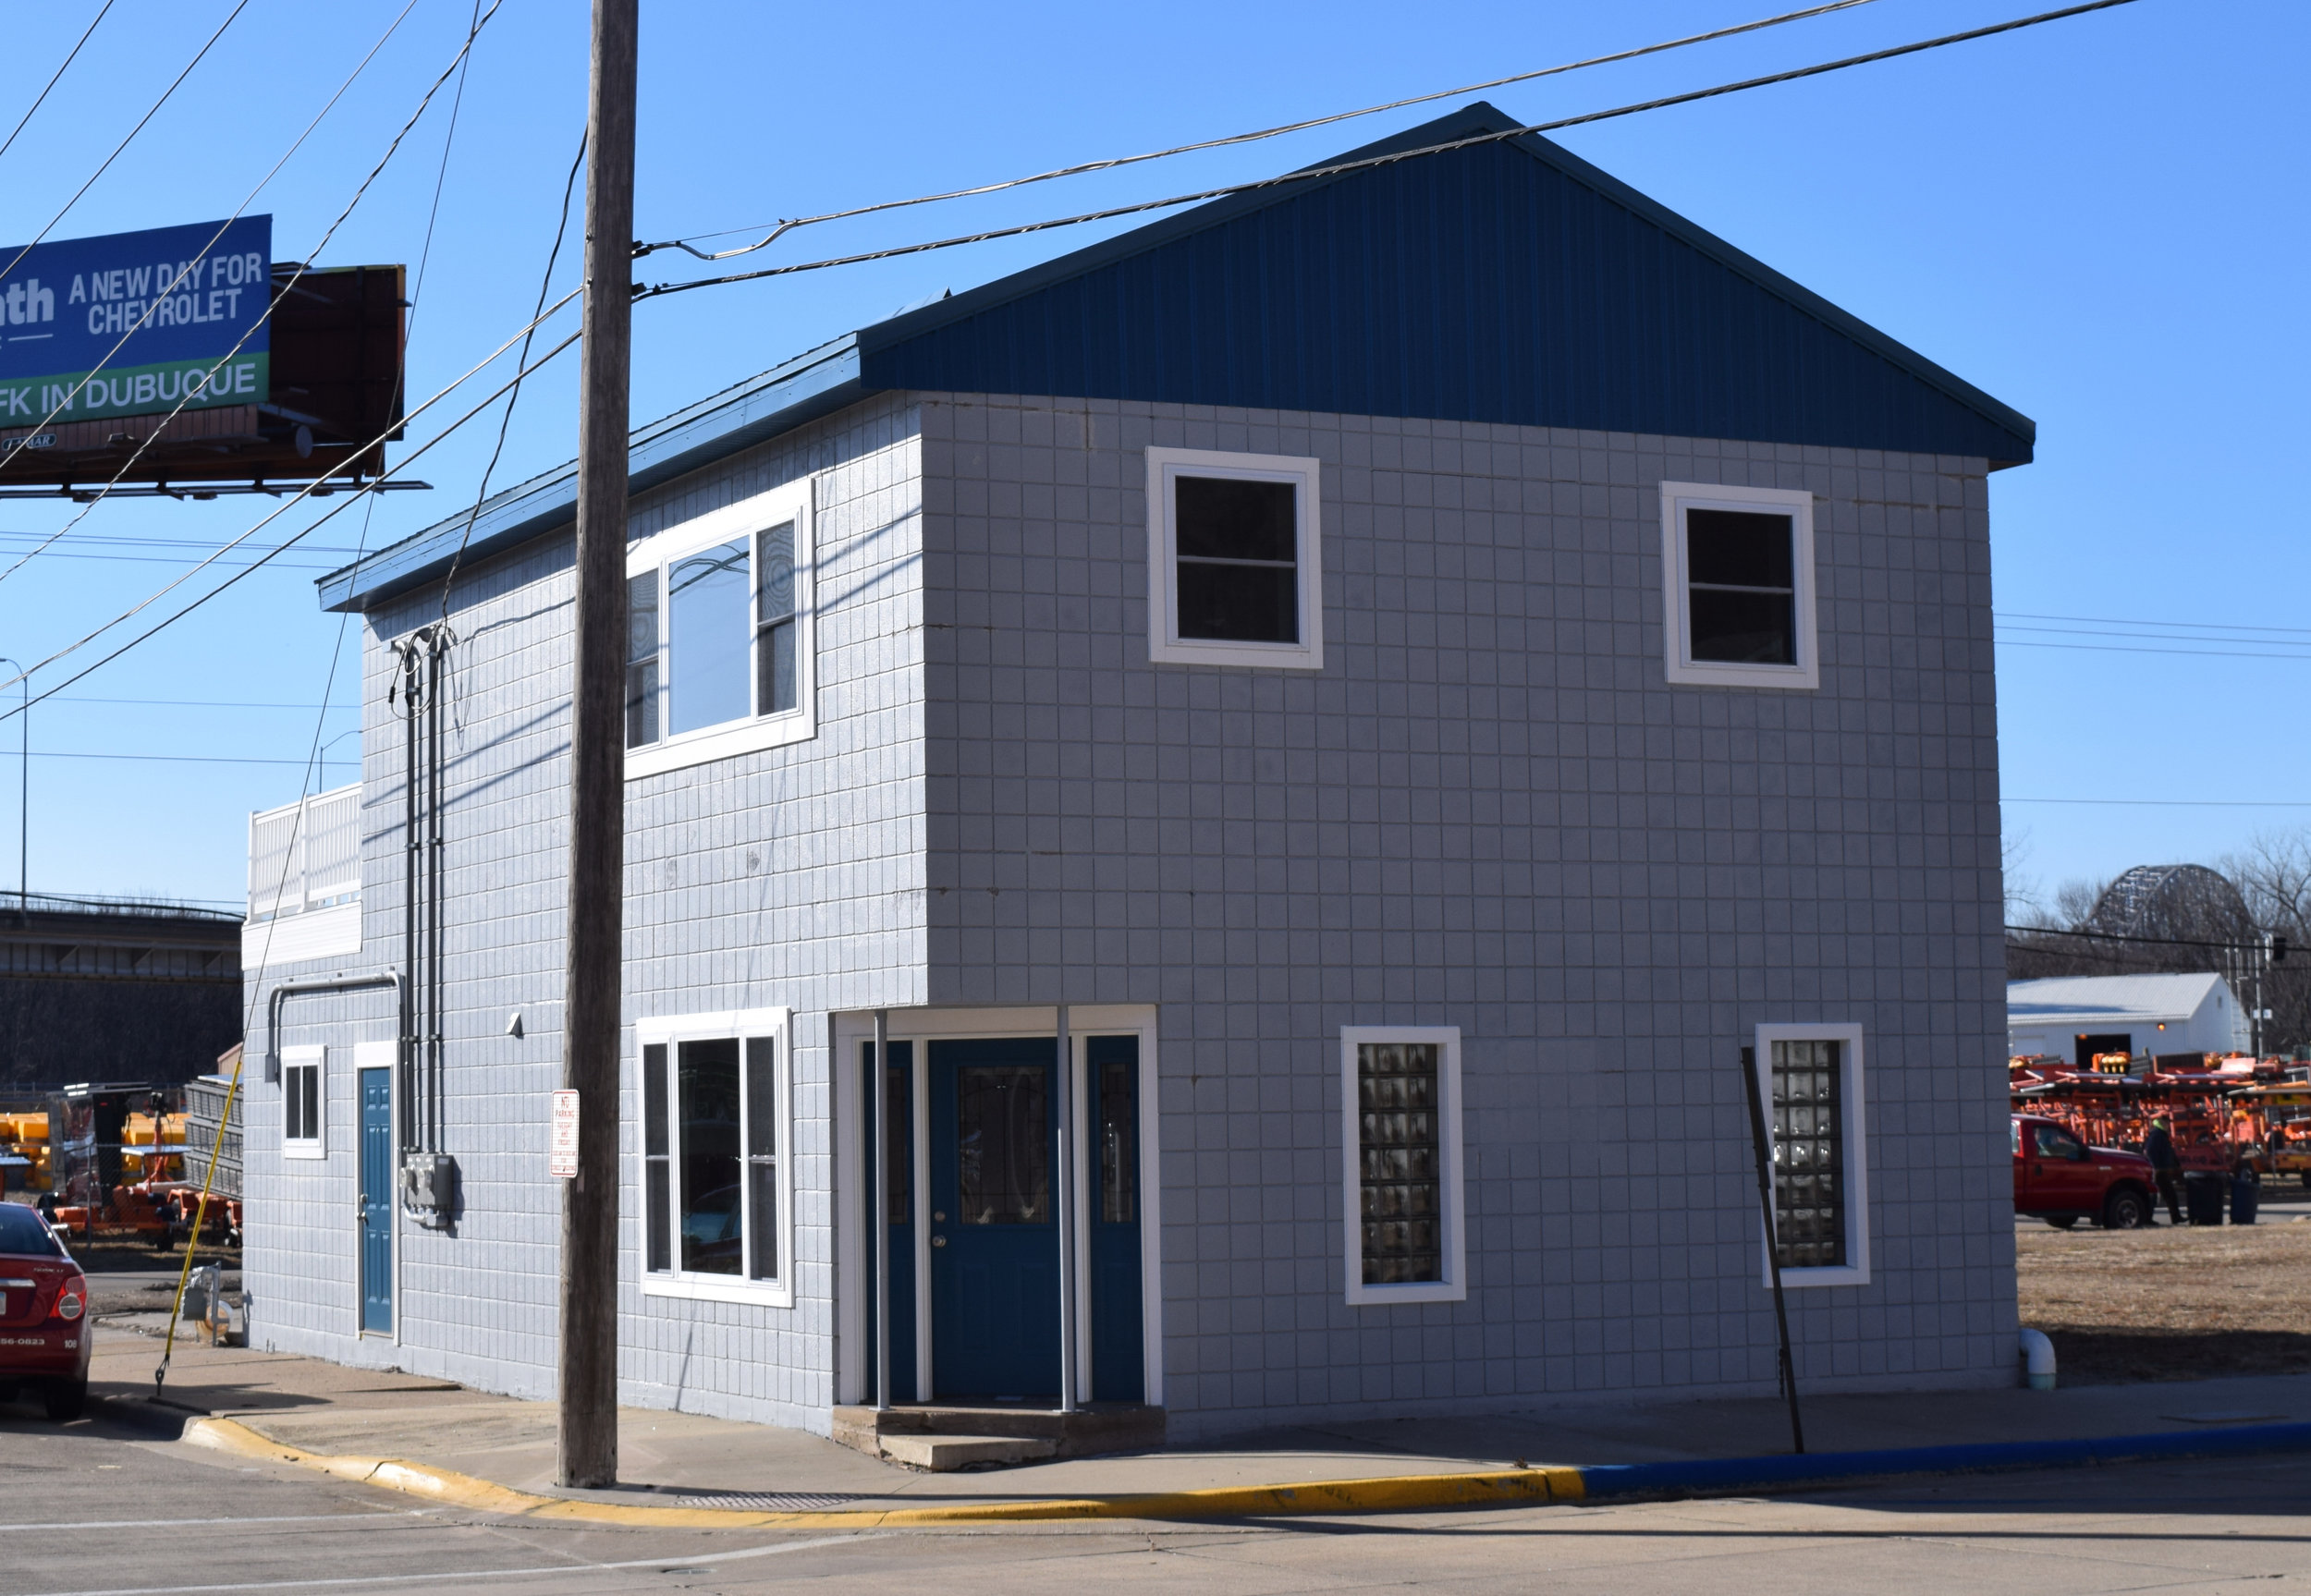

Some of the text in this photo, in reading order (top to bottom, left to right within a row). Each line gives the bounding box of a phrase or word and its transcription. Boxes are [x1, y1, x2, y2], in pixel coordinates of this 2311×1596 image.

[0, 278, 55, 326] th
[68, 252, 263, 305] A NEW DAY FOR
[88, 288, 242, 335] CHEVROLET
[42, 382, 74, 414] IN
[86, 362, 256, 408] DUBUQUE
[561, 1096, 569, 1108] NO
